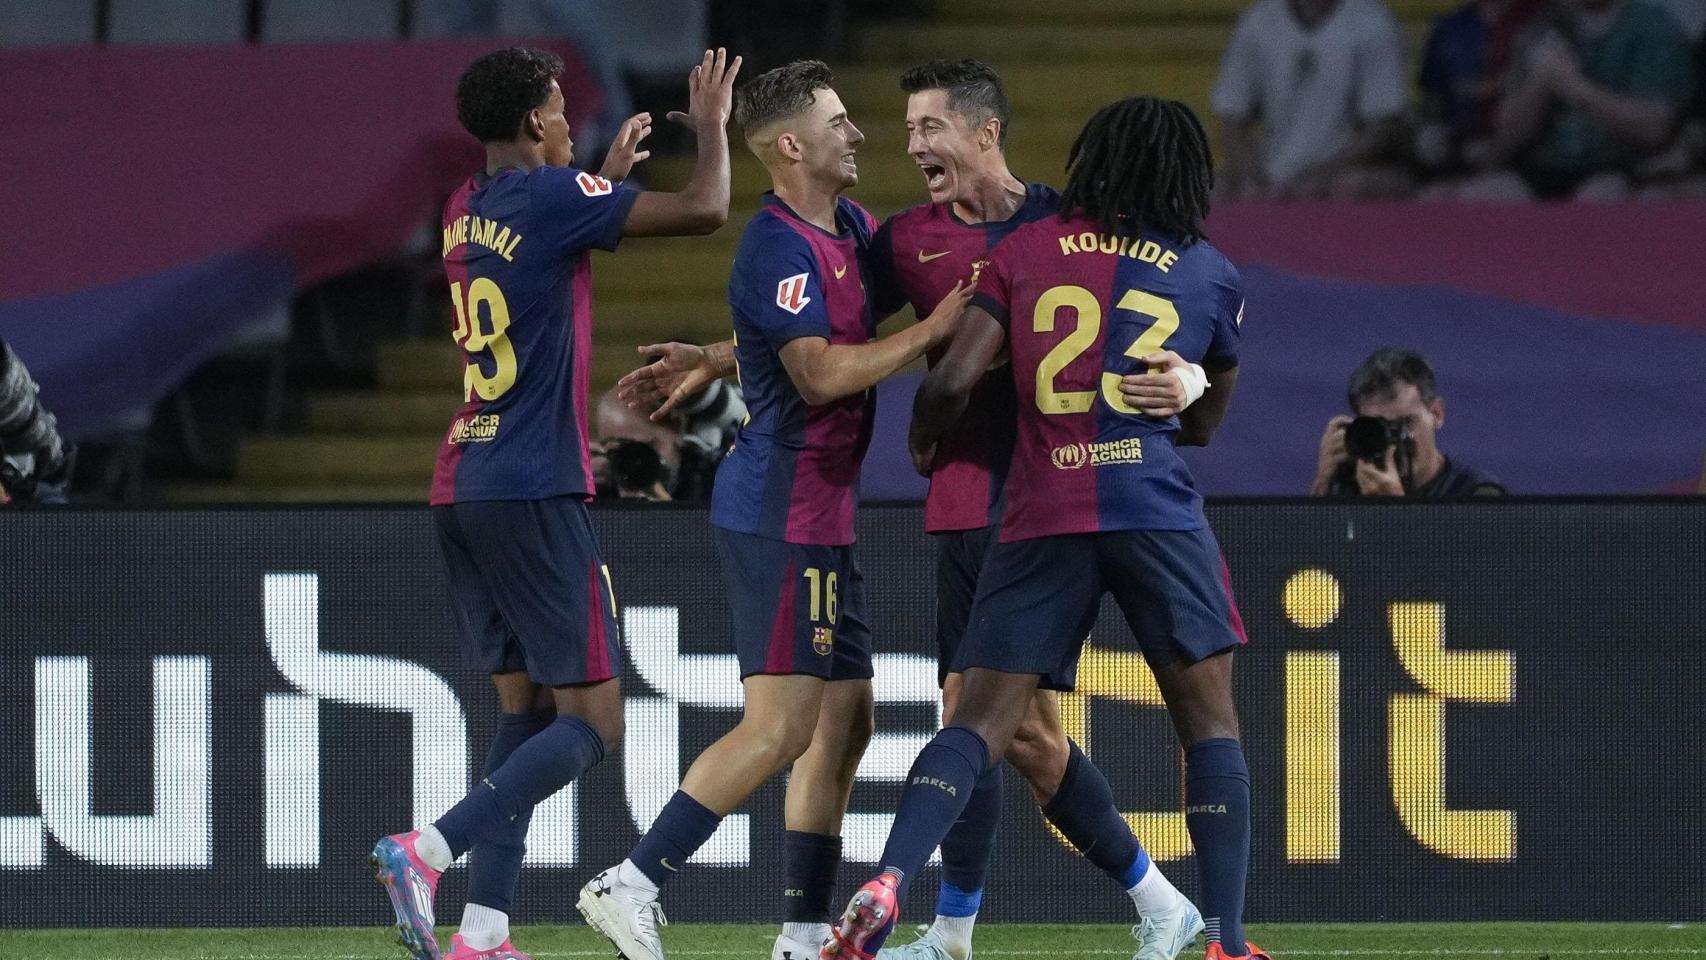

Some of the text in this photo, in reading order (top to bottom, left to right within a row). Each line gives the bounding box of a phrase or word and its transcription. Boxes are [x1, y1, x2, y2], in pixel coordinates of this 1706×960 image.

[1058, 232, 1179, 274] KOUNDE
[1033, 285, 1180, 414] 23
[1087, 437, 1142, 454] UNHCR
[1089, 447, 1143, 464] ACNUR
[803, 567, 837, 625] 16
